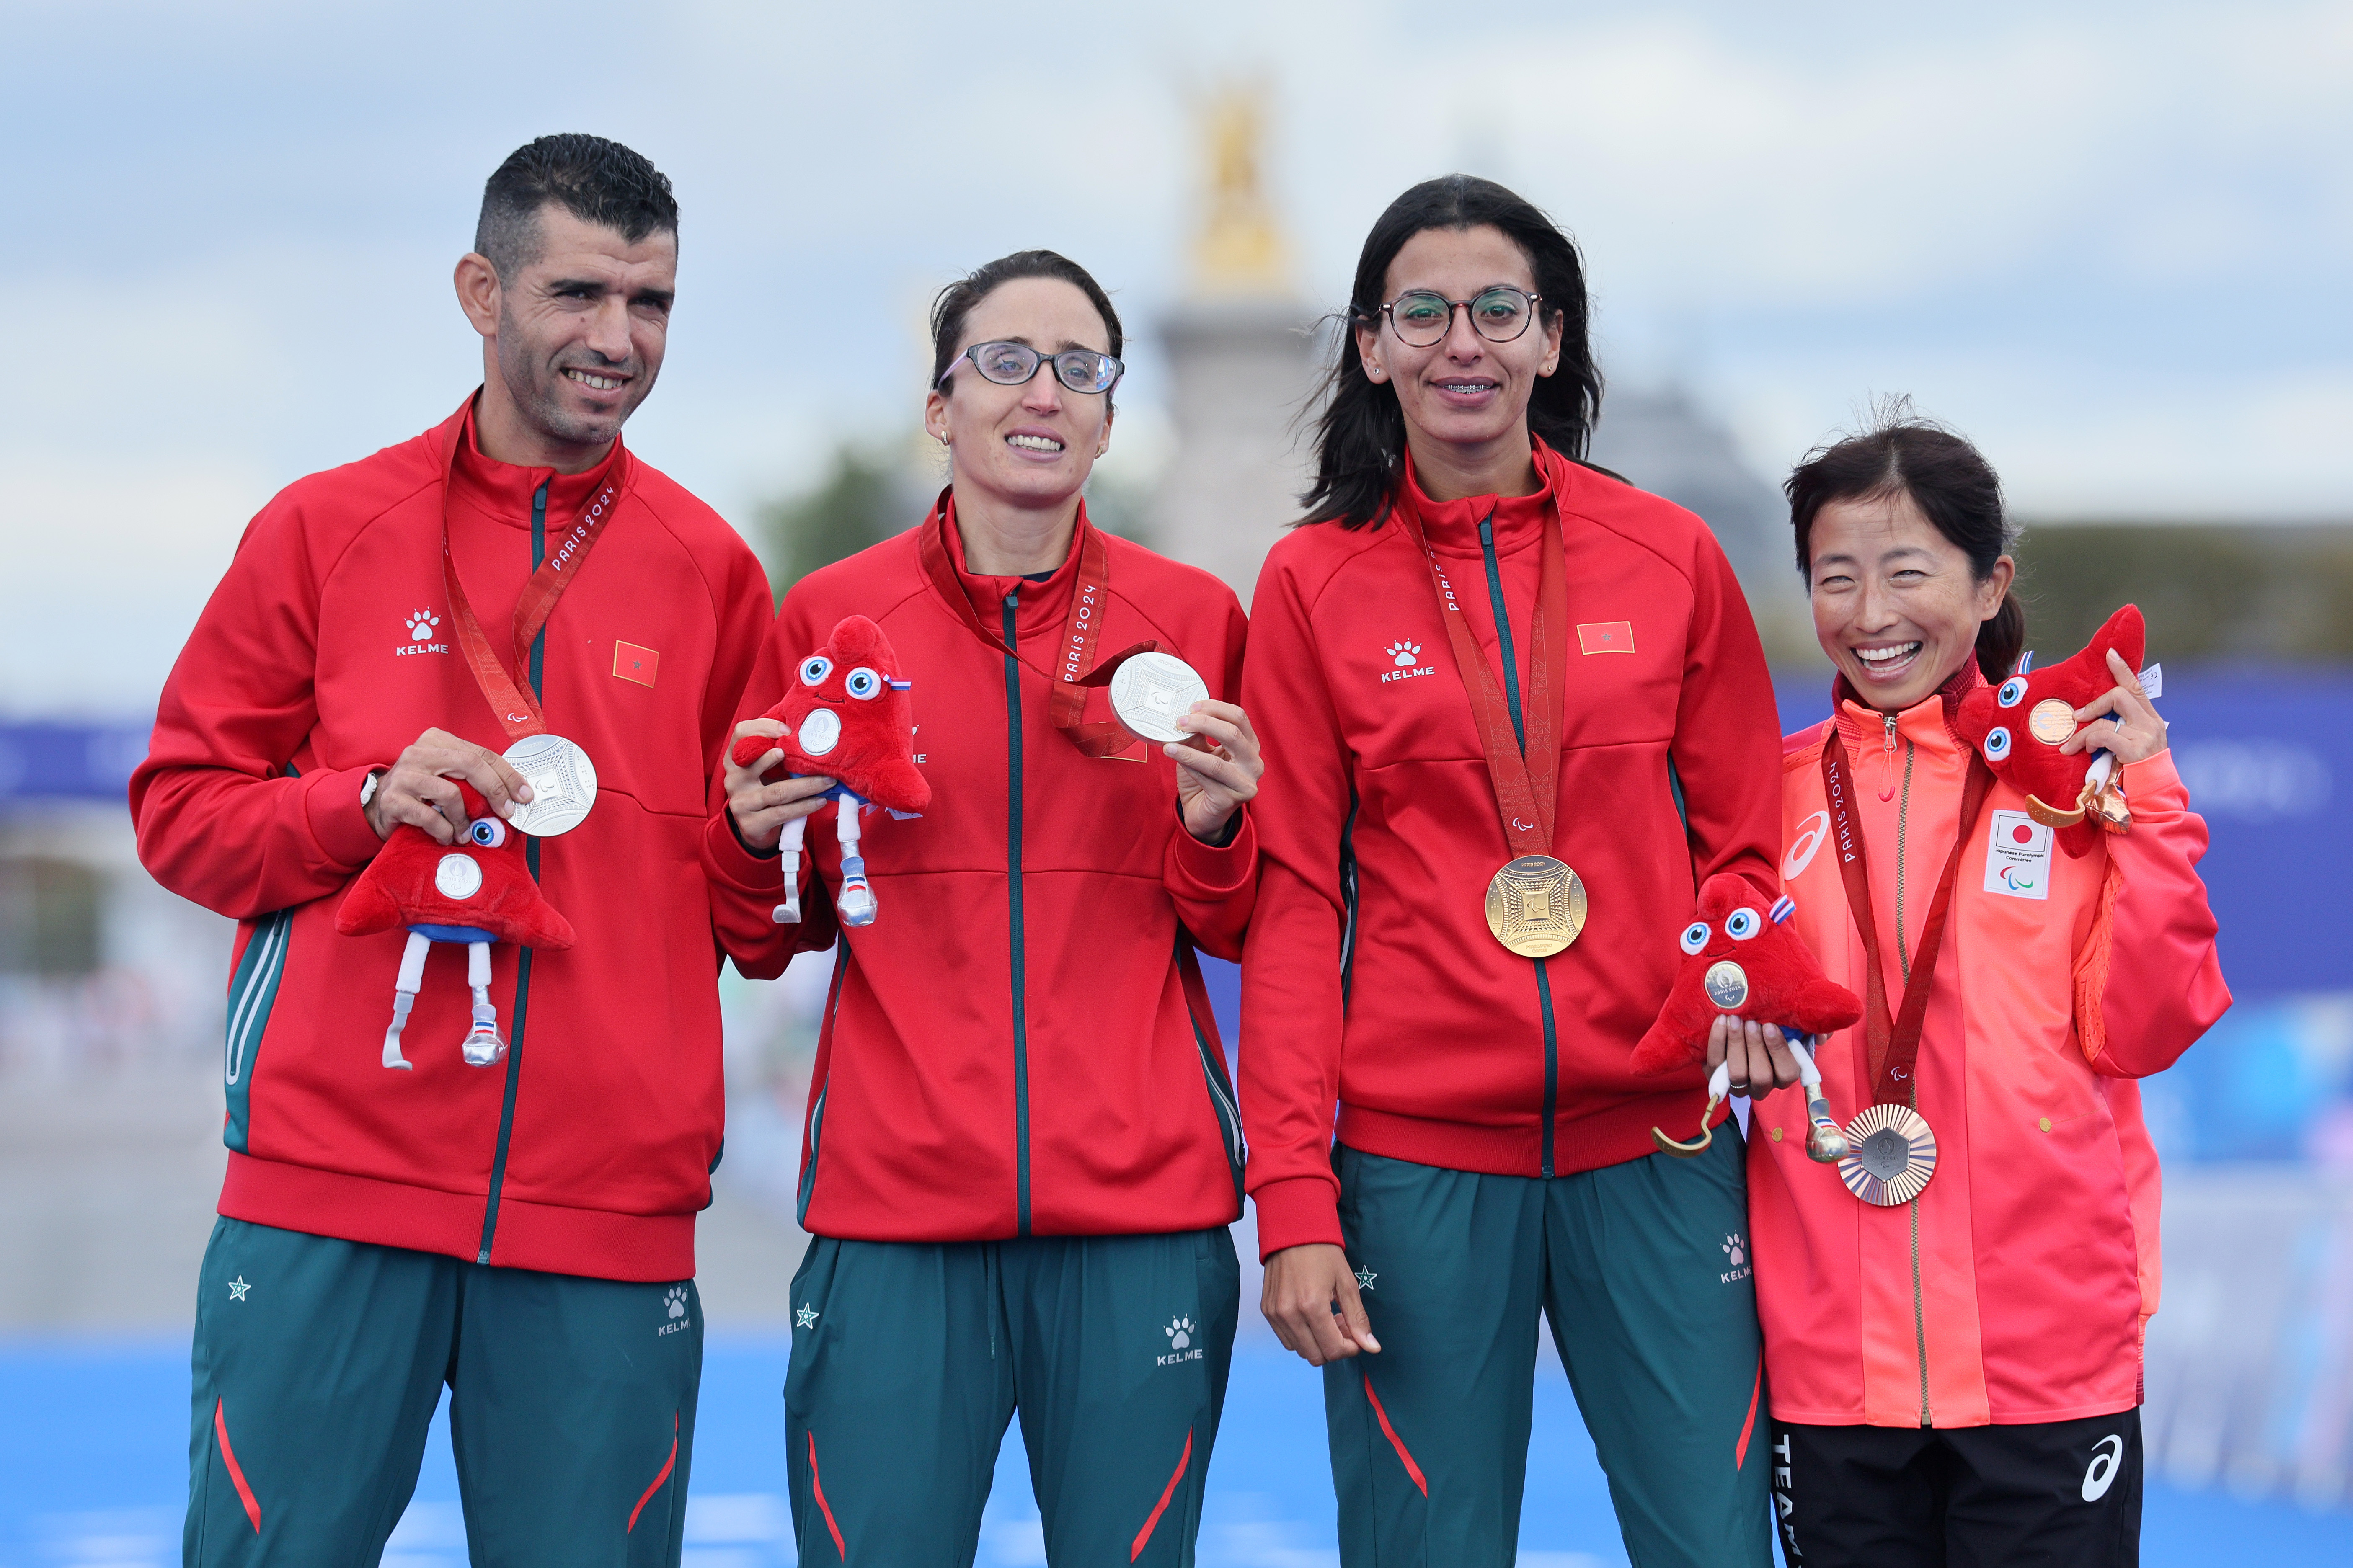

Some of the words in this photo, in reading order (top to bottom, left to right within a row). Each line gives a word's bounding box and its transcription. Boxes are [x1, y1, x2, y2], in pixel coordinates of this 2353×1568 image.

[585, 486, 614, 526] 2024
[1076, 585, 1096, 631] 2024
[396, 643, 449, 656] KELME
[1381, 666, 1435, 683] KELME
[1829, 761, 1844, 808] 2024
[1720, 1265, 1752, 1284] KELME
[1157, 1349, 1203, 1366] KELME
[1772, 1434, 1803, 1557] TEAM
